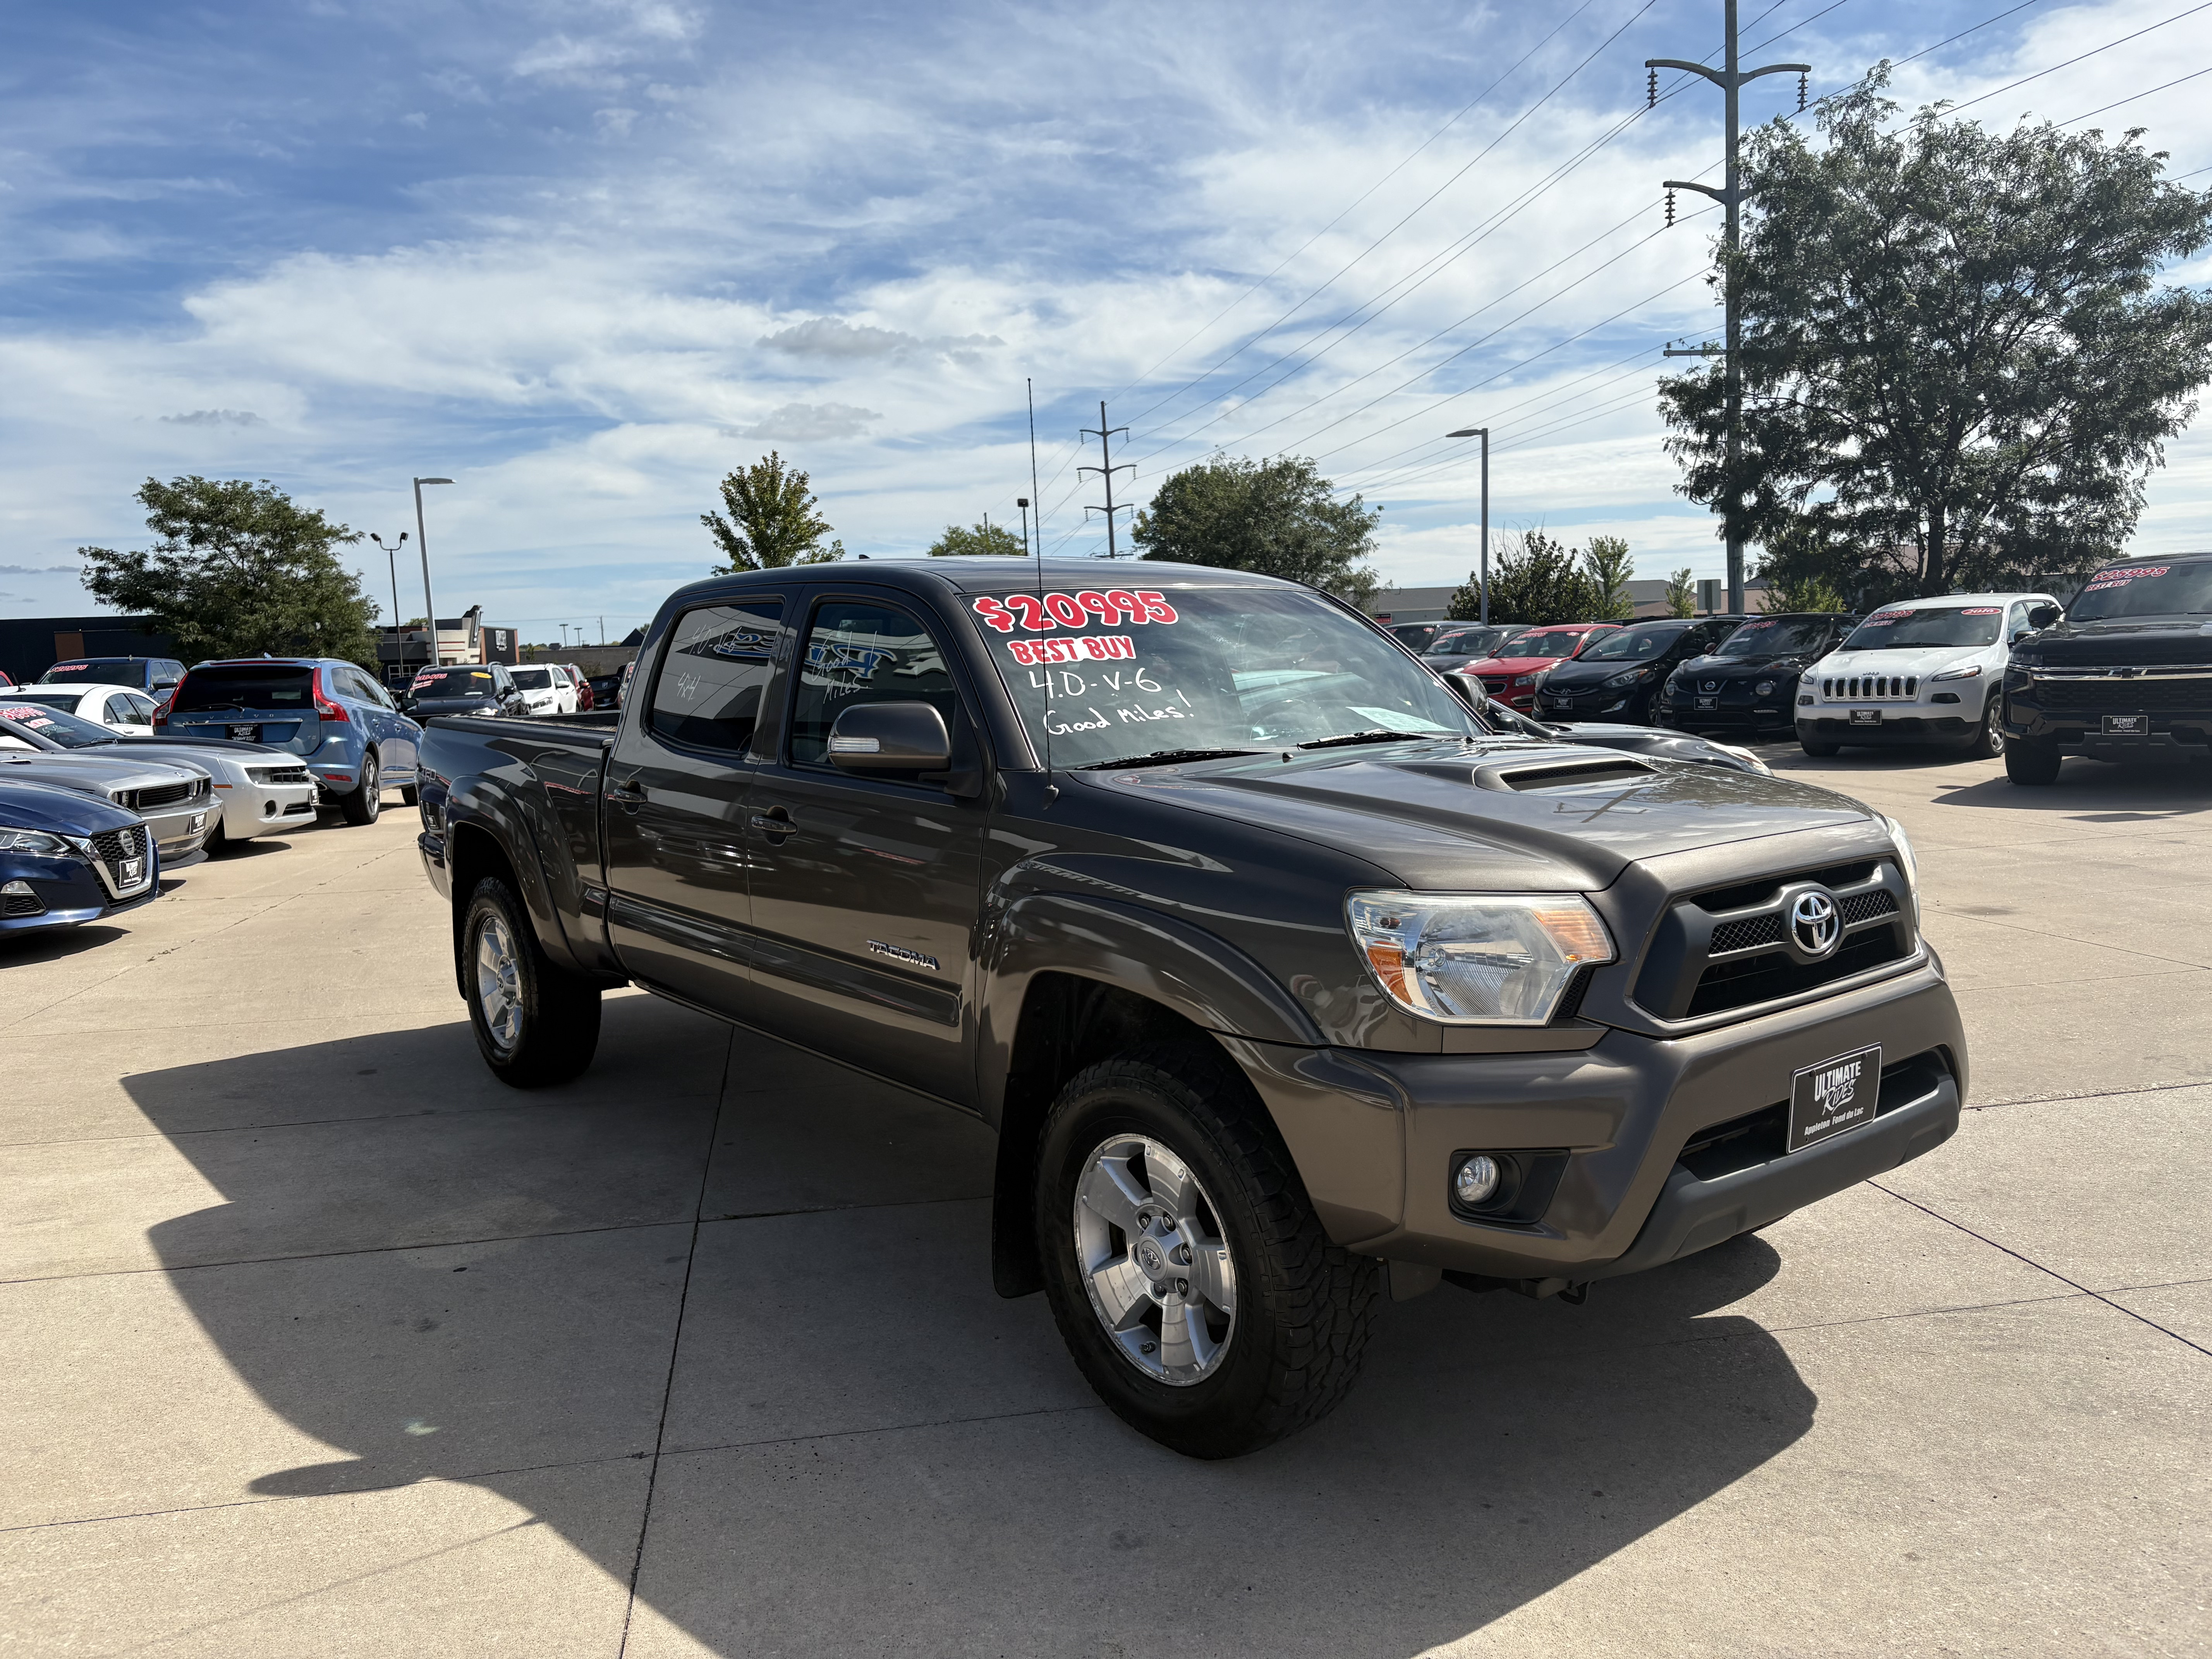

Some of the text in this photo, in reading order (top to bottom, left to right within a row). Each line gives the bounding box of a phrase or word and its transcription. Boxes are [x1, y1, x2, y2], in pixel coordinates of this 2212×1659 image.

[2085, 579, 2132, 592] BEST BUY
[2092, 567, 2171, 582] $25995
[973, 590, 1178, 633] $20995
[812, 631, 852, 682] Good
[1008, 635, 1136, 665] BEST BUY
[677, 672, 701, 702] 4x4
[1043, 707, 1111, 735] Good
[421, 766, 436, 783] TRD
[866, 939, 941, 970] TACOMA
[1814, 1061, 1861, 1102] ULTIMATE
[1804, 1107, 1864, 1135] Appleton Fond du Lac
